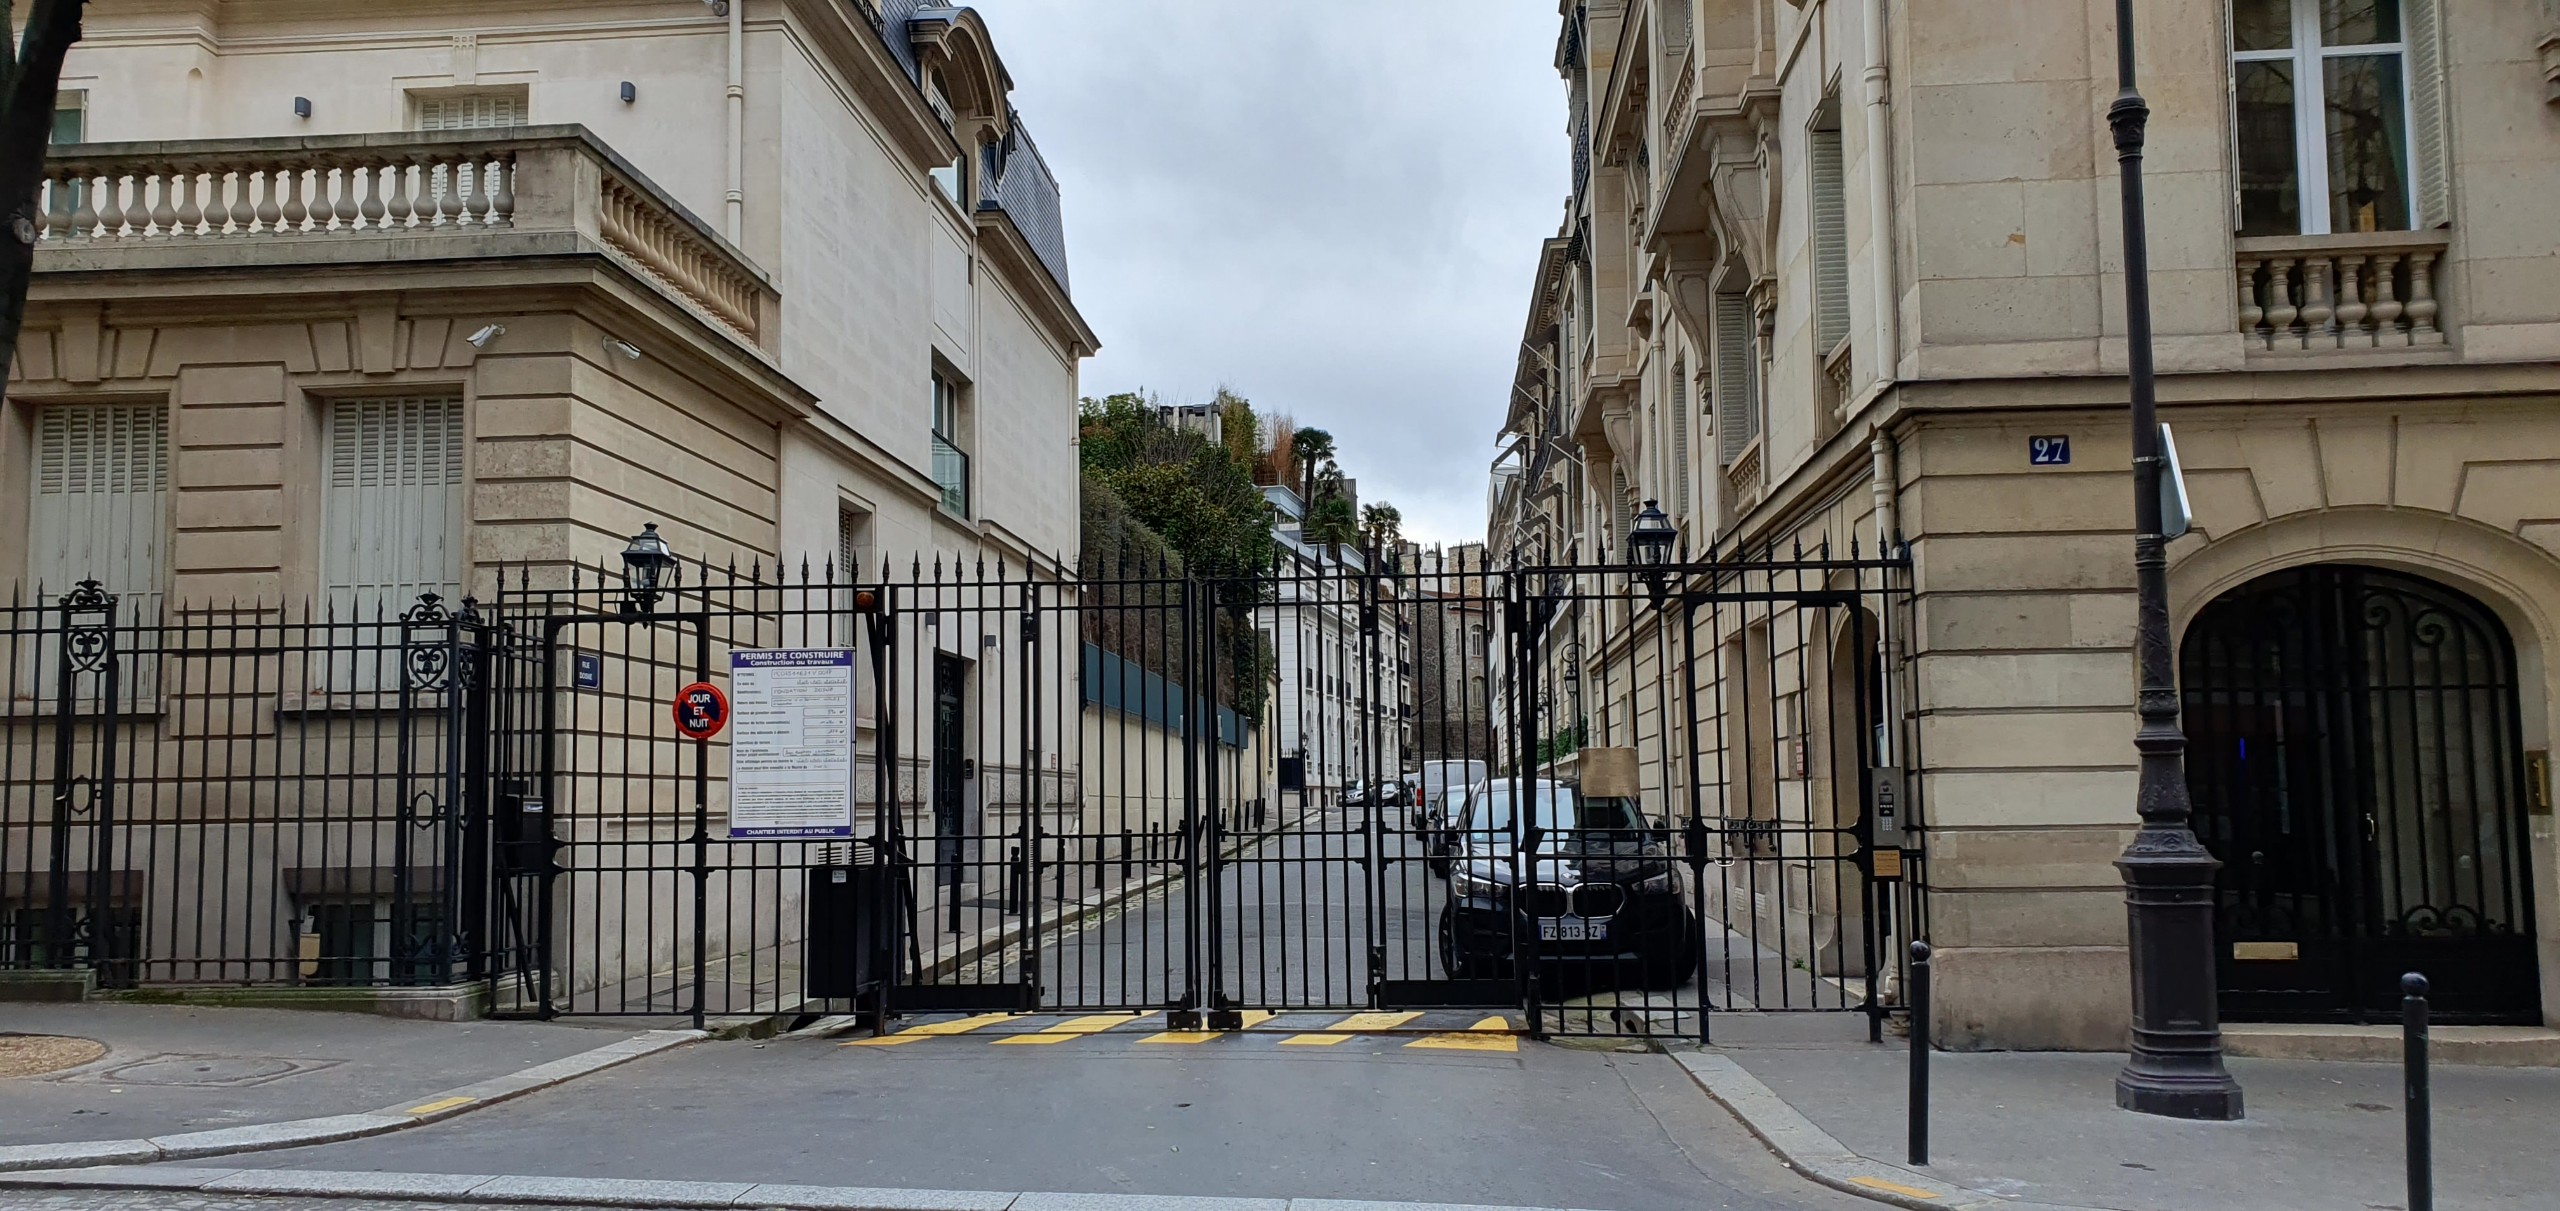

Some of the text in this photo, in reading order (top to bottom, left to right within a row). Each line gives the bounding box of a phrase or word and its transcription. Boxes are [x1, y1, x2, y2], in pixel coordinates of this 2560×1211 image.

[2034, 437, 2065, 462] 27
[740, 651, 844, 660] PERMIS DE CONSTRUIRE
[687, 693, 711, 704] JOUR
[693, 706, 705, 716] ET
[689, 718, 709, 728] NUIT
